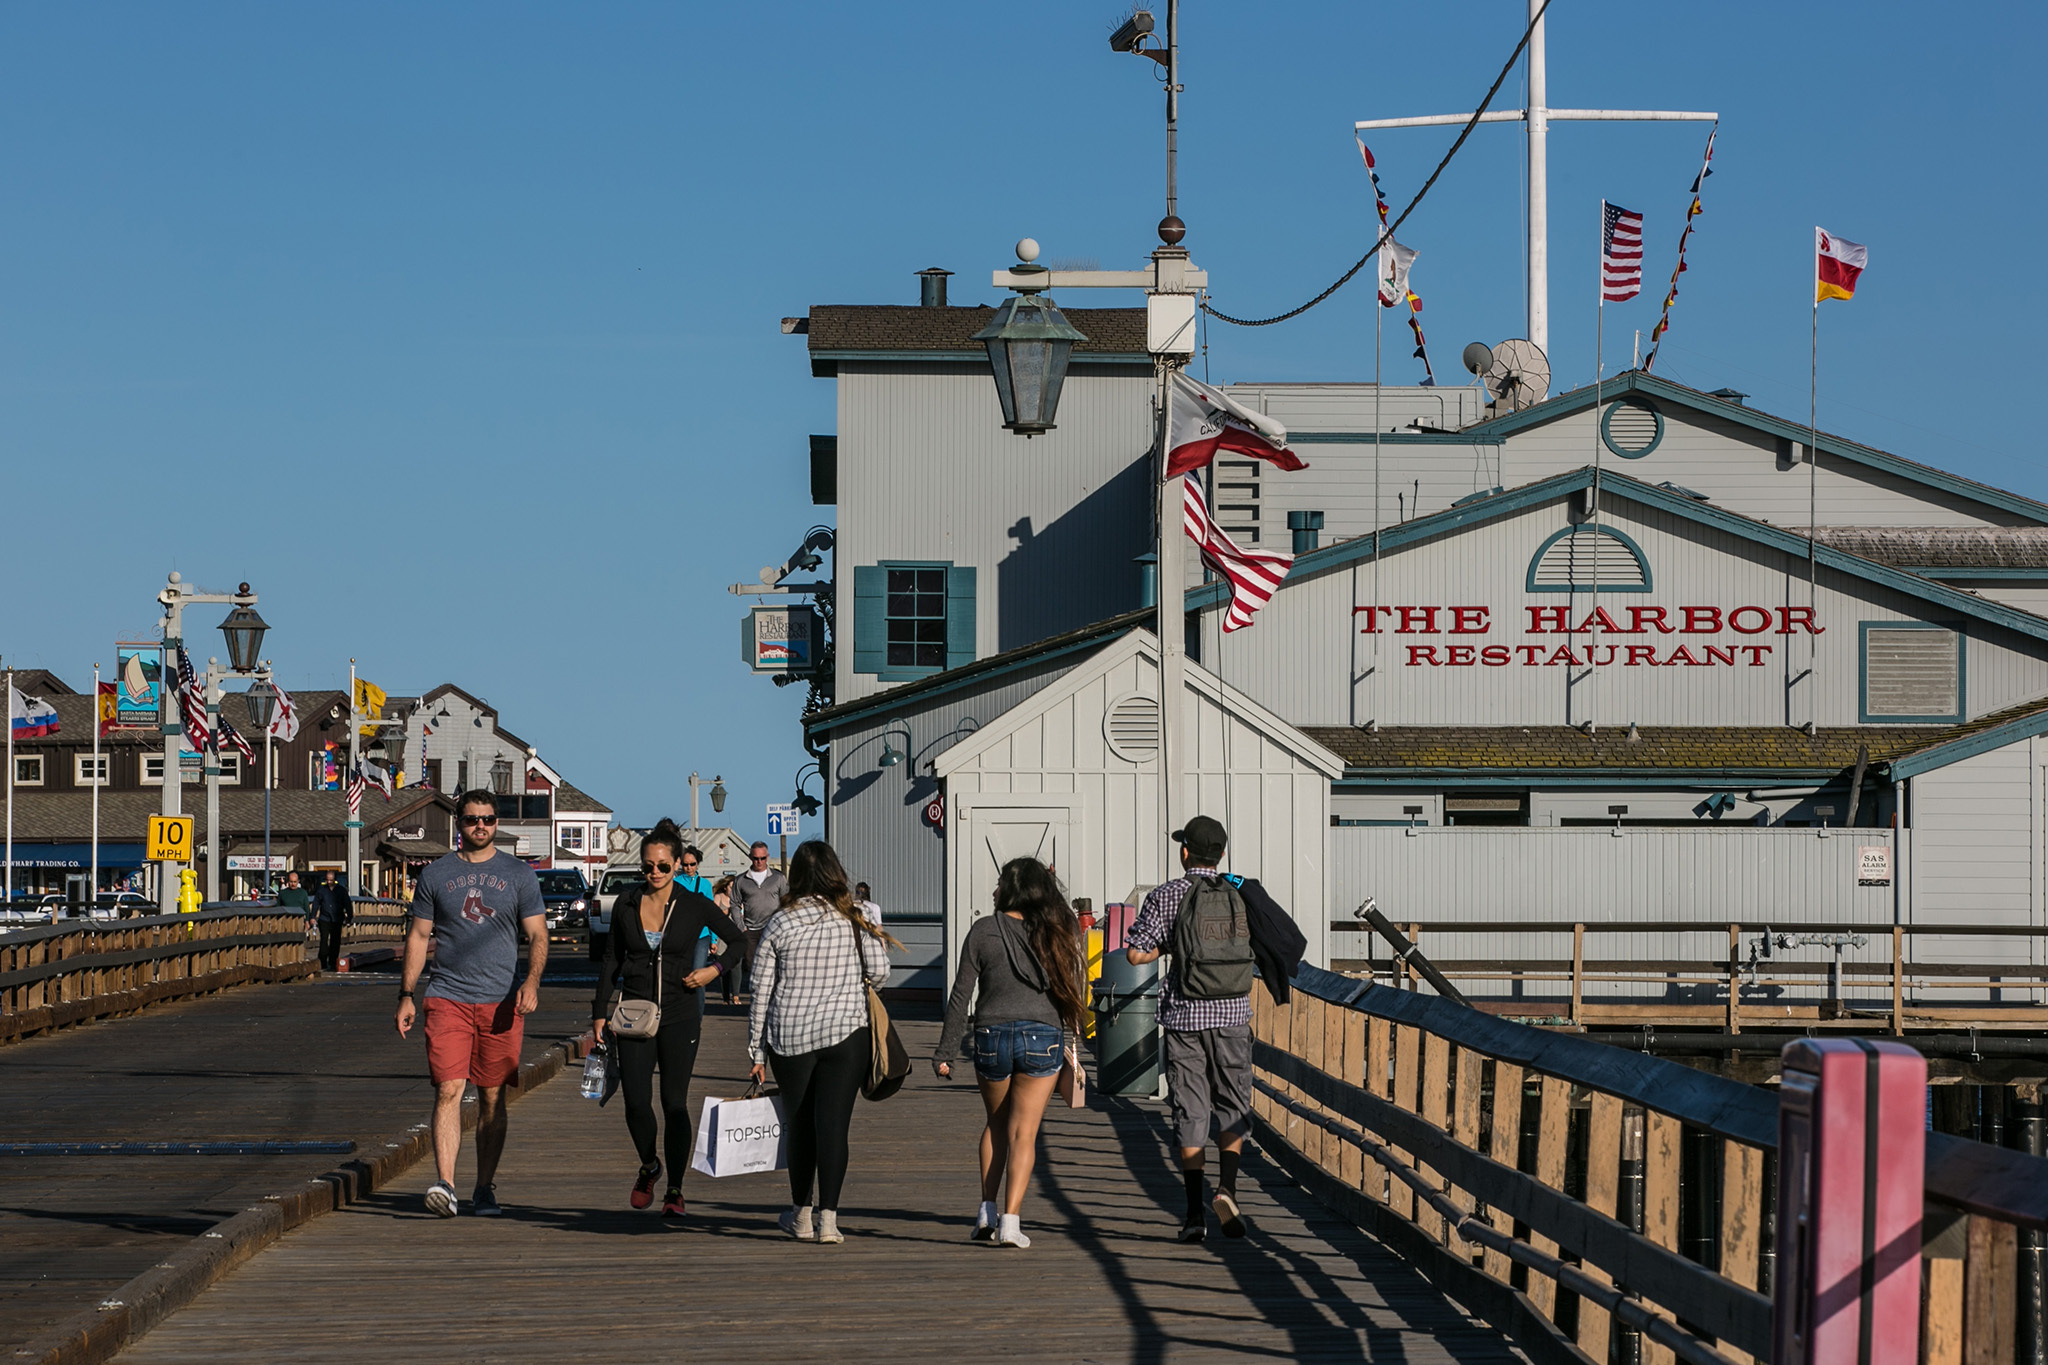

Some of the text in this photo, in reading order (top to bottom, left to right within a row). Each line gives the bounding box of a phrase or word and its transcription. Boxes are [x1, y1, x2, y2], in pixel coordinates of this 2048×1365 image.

[759, 620, 808, 634] HARBOR
[767, 614, 784, 625] THE
[1351, 605, 1826, 635] THE HARBOR
[759, 631, 809, 640] RESTAURANT
[1405, 644, 1773, 667] RESTAURANT
[158, 822, 183, 845] 10
[157, 849, 182, 858] MPH
[446, 873, 508, 892] BOSTON
[1197, 911, 1250, 940] VANS
